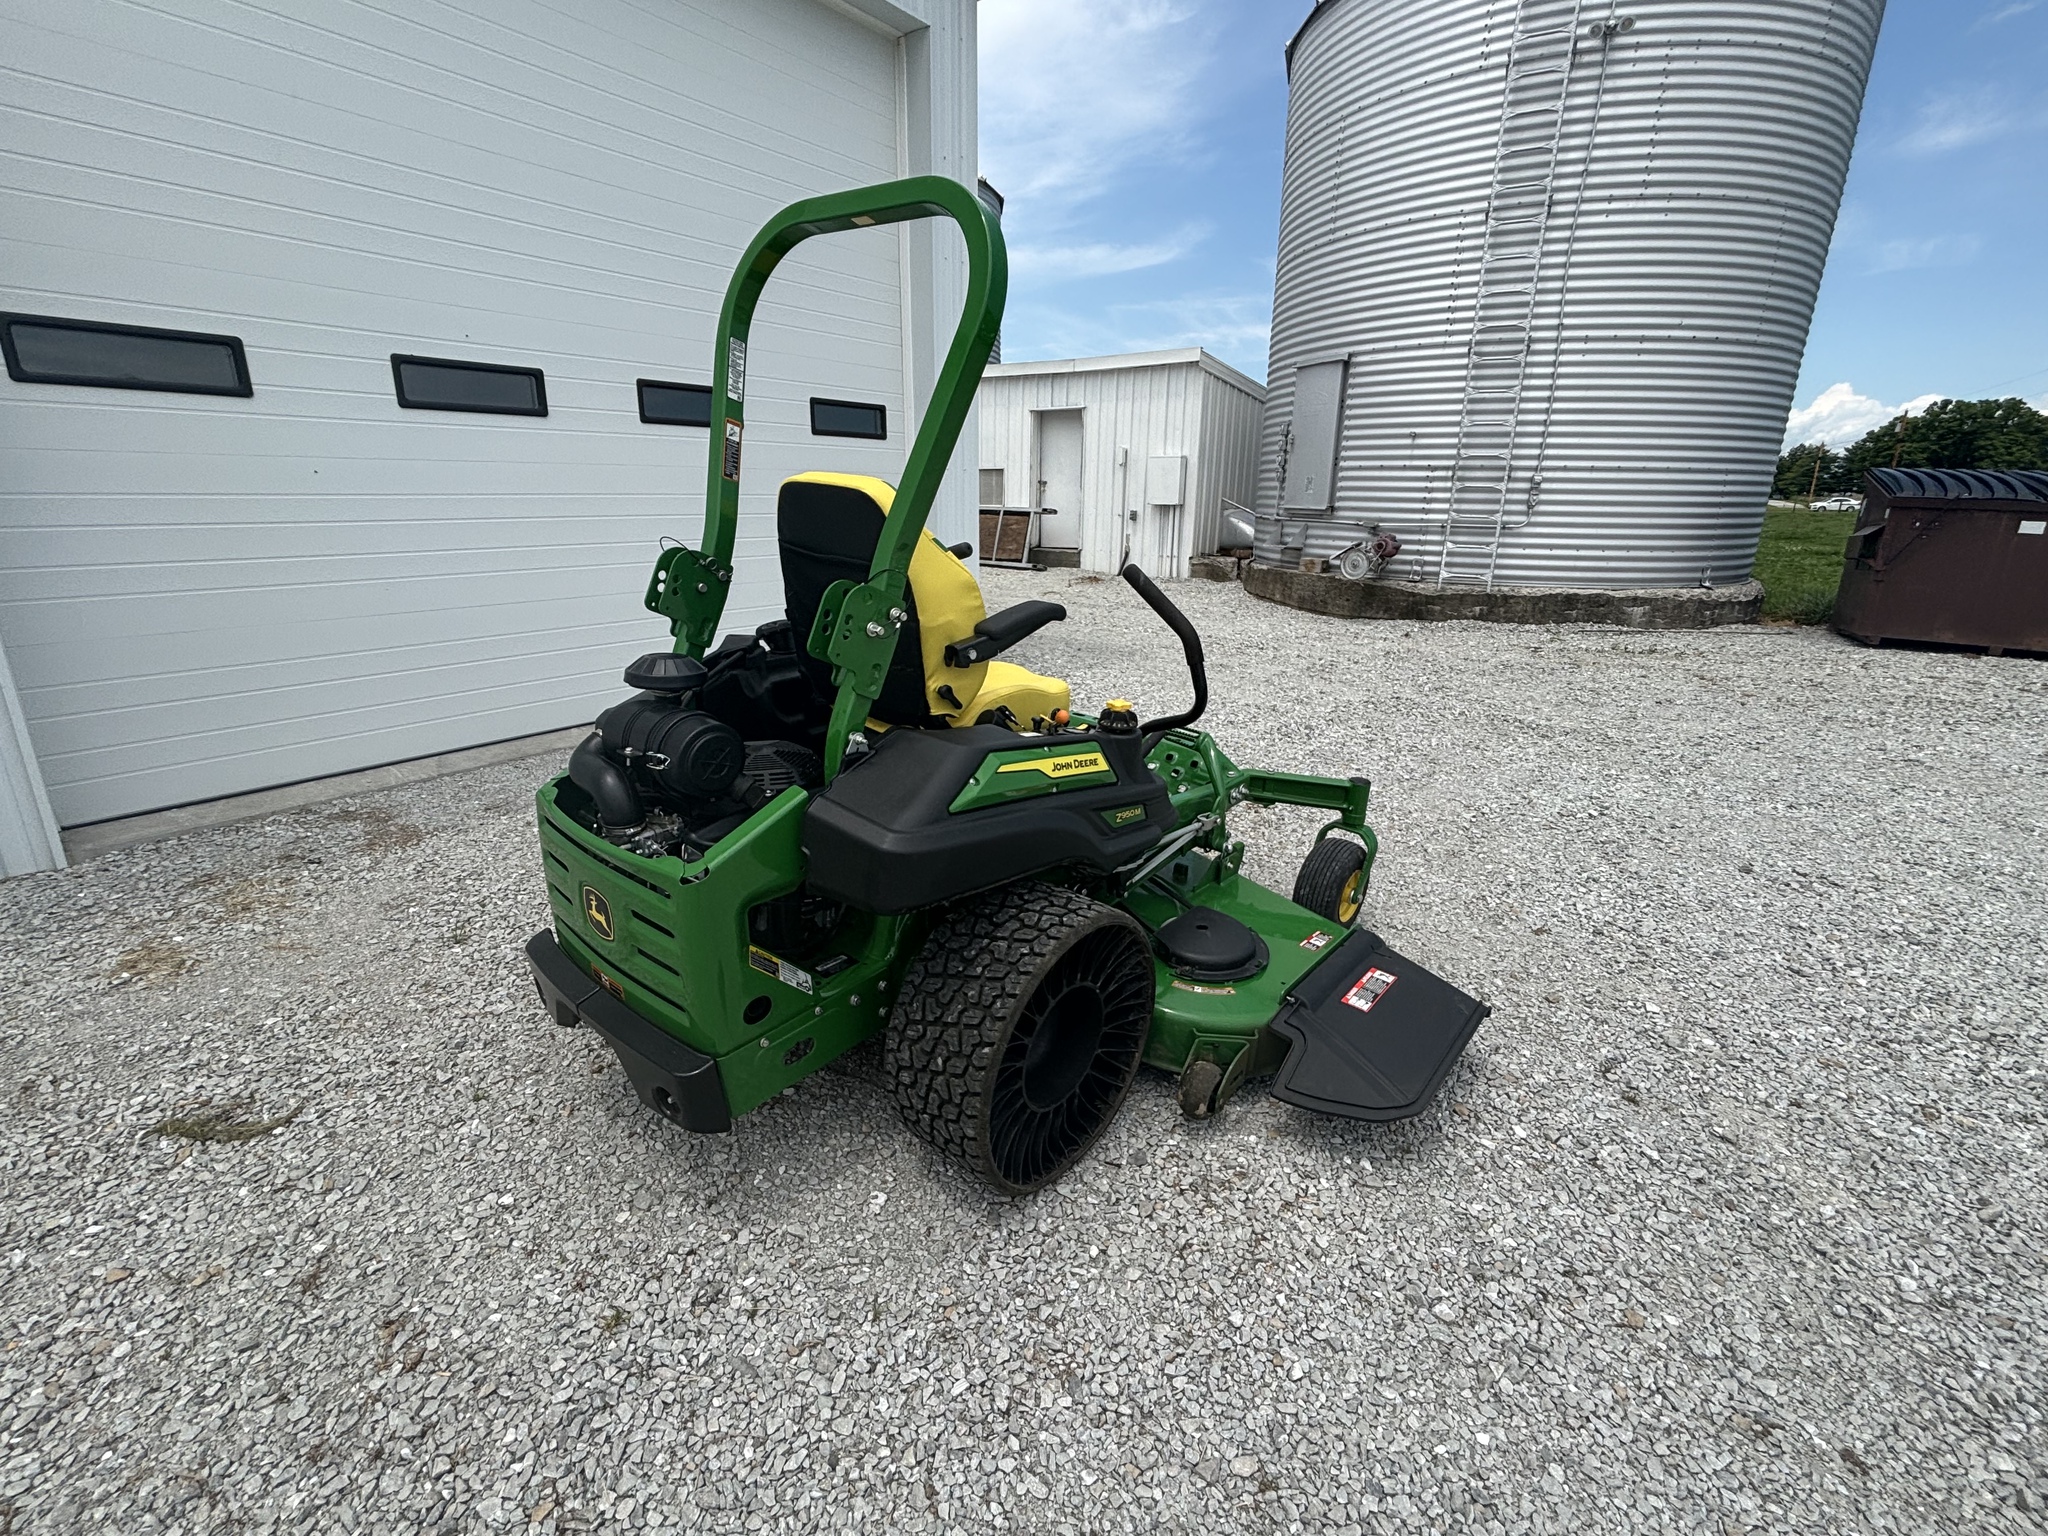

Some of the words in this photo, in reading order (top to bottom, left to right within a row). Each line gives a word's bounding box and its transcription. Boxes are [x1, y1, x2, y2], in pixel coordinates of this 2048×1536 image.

[1052, 762, 1073, 772] JOHN
[1073, 758, 1099, 769] DEERE
[1115, 808, 1142, 823] Z950M
